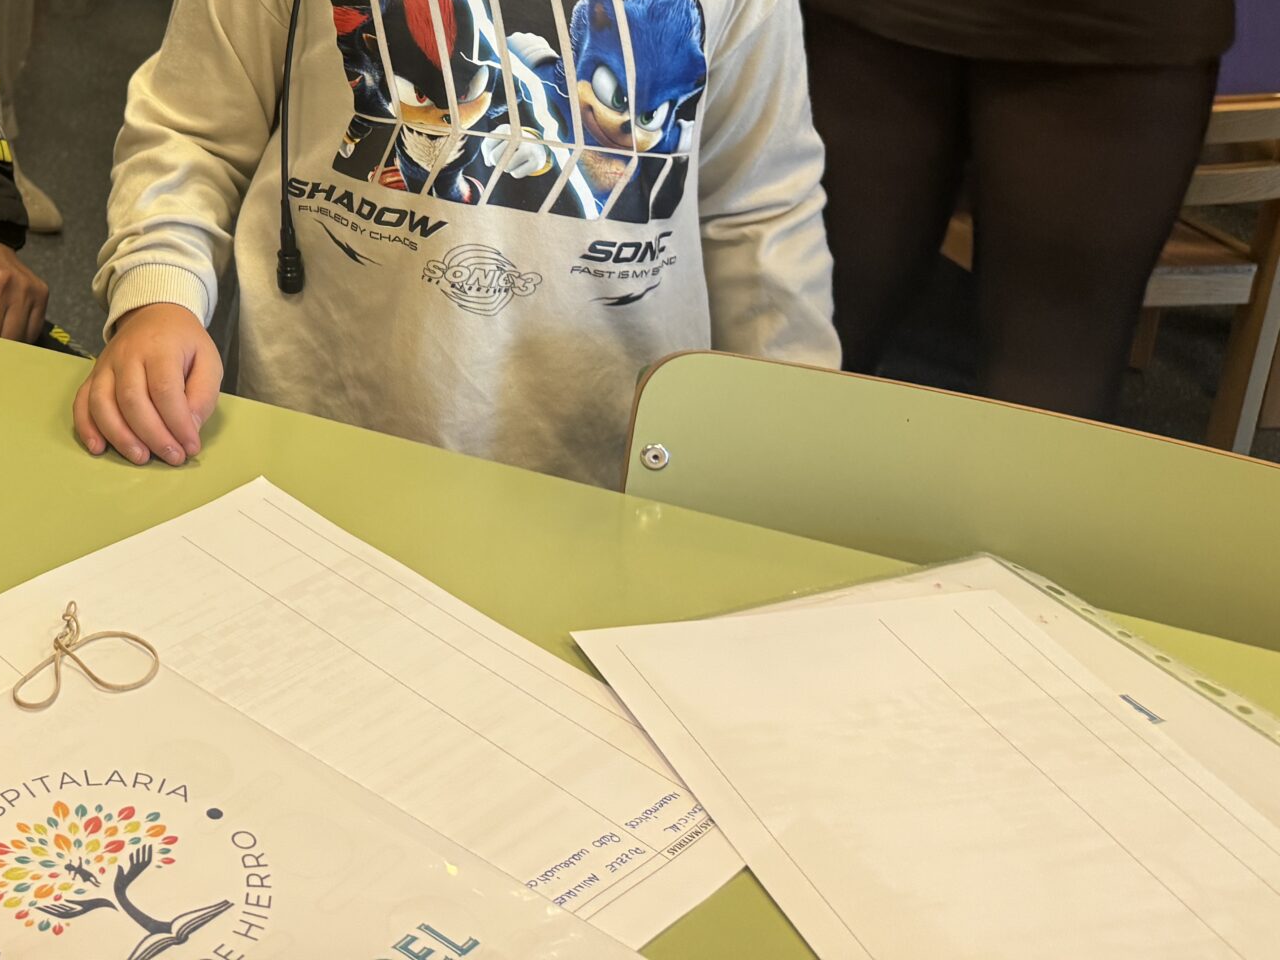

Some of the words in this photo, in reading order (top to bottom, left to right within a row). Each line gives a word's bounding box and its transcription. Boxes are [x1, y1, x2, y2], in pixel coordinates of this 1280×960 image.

[287, 176, 449, 239] SHADOW
[298, 204, 349, 228] FUELED
[350, 223, 367, 236] BY
[579, 230, 673, 263] SONC
[511, 271, 543, 297] 3
[570, 265, 616, 279] FAST
[617, 270, 630, 279] IS
[631, 268, 651, 279] MY
[231, 830, 273, 942] HIERRO
